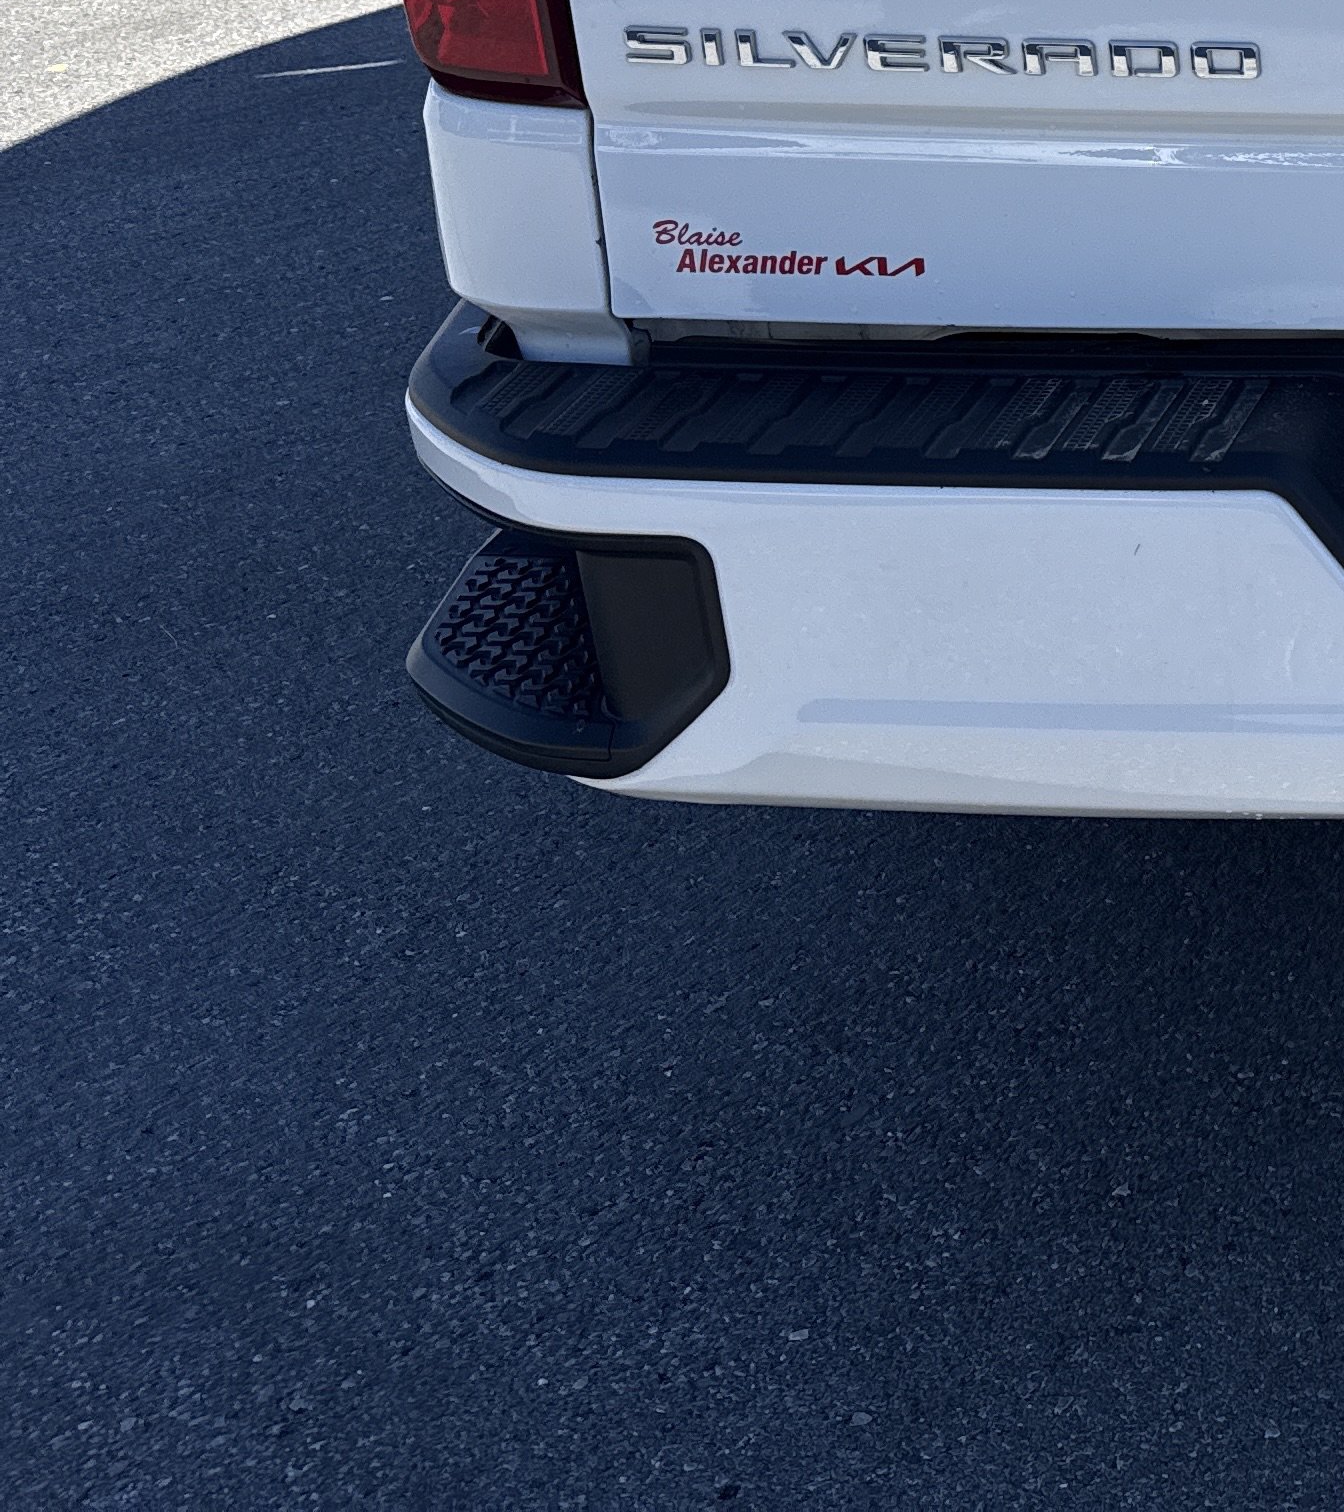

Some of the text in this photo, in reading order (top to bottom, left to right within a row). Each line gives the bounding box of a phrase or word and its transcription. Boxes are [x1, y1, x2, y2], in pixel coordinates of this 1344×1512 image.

[623, 24, 1263, 79] SILVERADO
[652, 218, 744, 248] Blaise
[676, 249, 829, 276] Alexander
